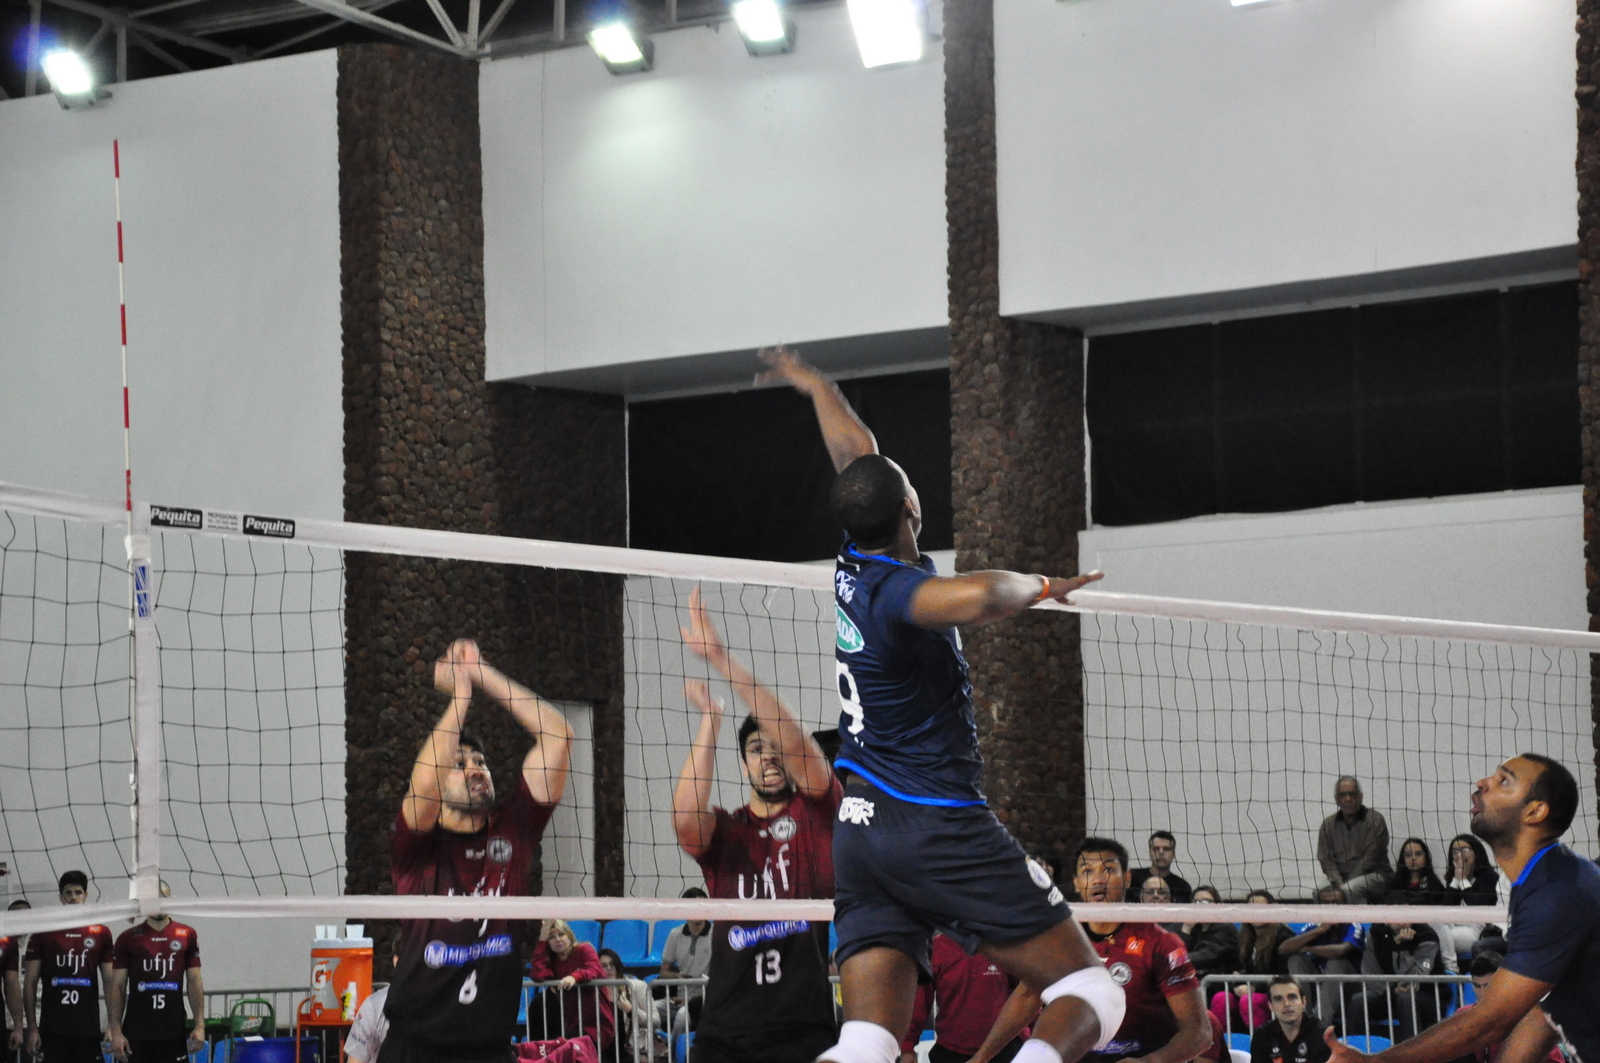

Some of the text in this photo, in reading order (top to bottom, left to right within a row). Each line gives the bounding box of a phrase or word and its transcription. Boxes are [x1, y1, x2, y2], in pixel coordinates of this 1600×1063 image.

[151, 507, 201, 525] Pequita
[245, 516, 294, 535] Pequita
[836, 618, 857, 646] ADA
[56, 949, 88, 975] ufjf
[143, 952, 176, 979] ufjf
[755, 949, 782, 986] 13
[61, 990, 79, 1004] 20
[458, 969, 478, 1005] 6
[152, 994, 166, 1009] 15
